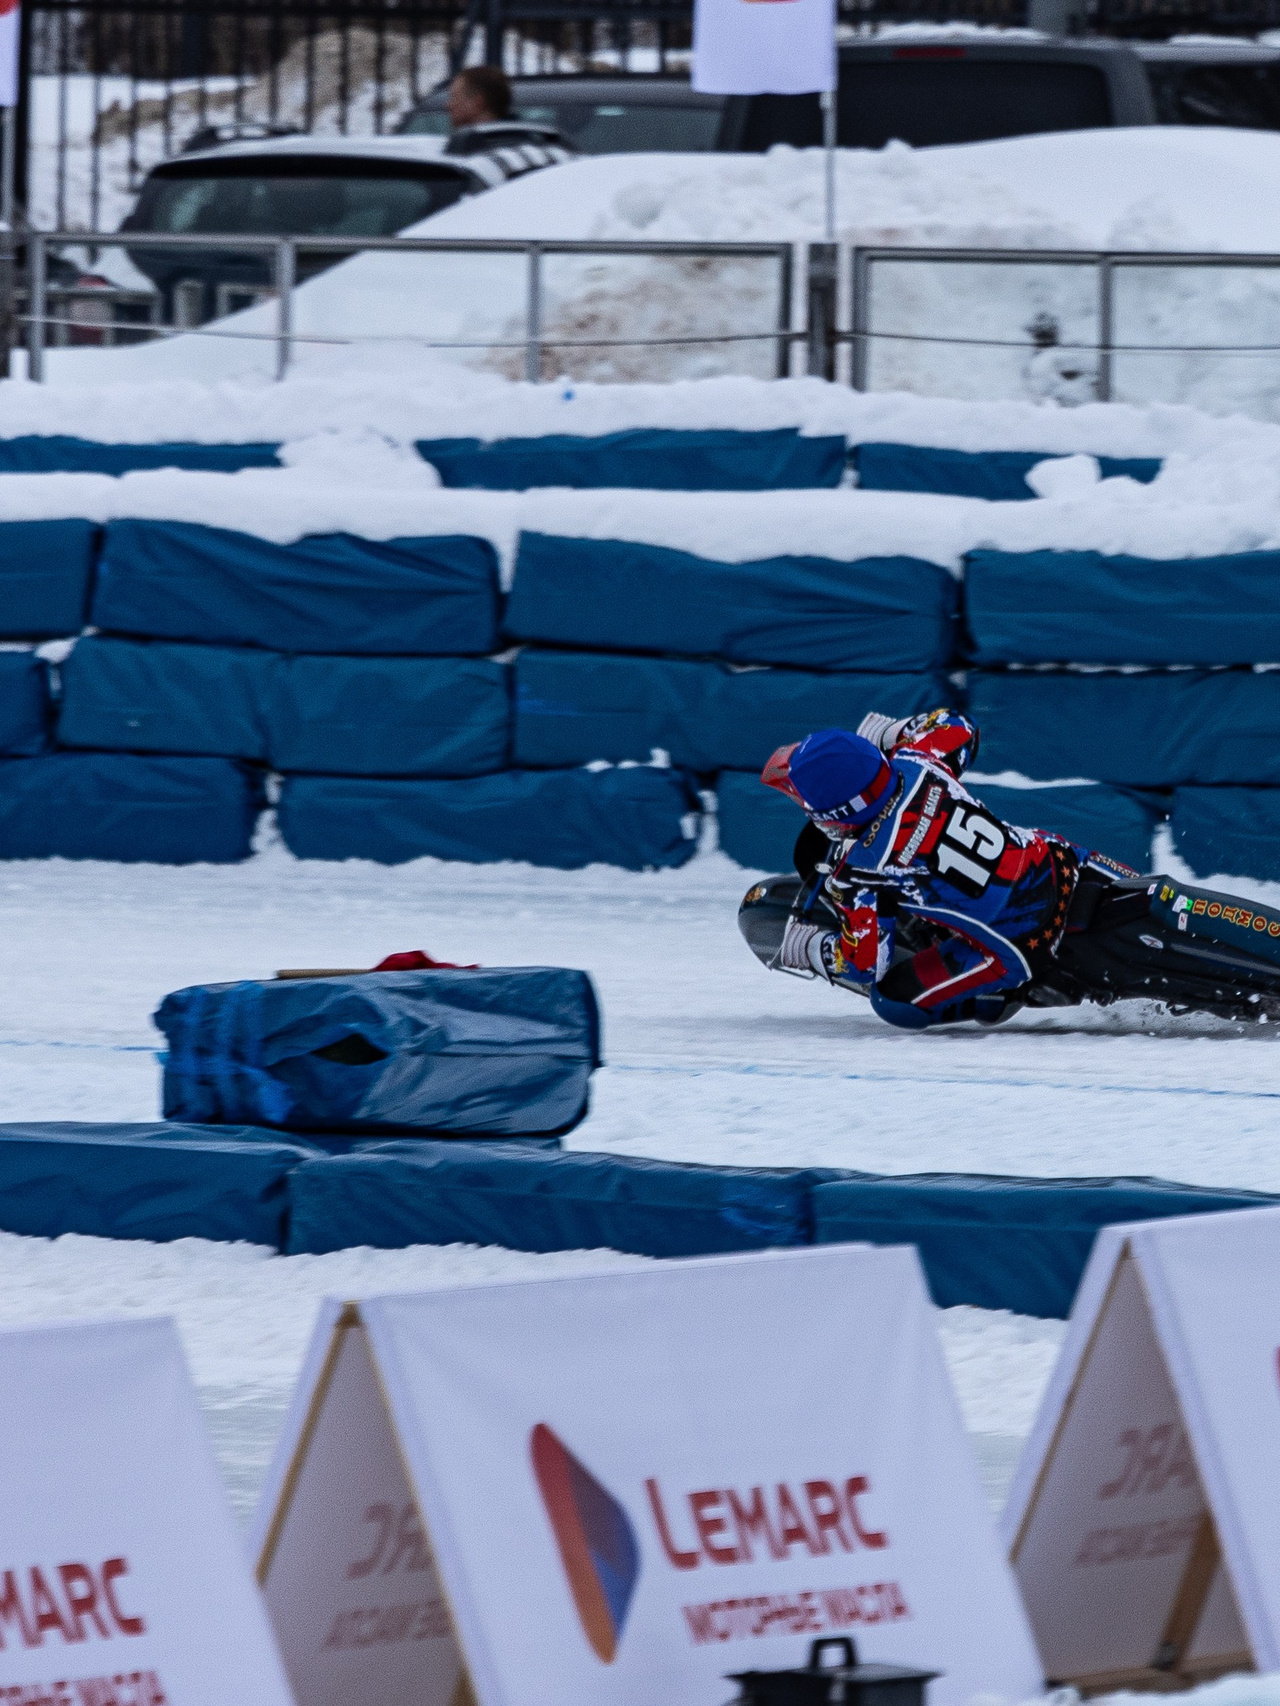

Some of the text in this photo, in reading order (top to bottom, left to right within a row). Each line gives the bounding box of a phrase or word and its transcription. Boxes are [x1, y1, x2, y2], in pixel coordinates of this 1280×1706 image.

[938, 806, 1005, 887] 15
[643, 1476, 889, 1571] LEMARC
[0, 1558, 147, 1651] MARC
